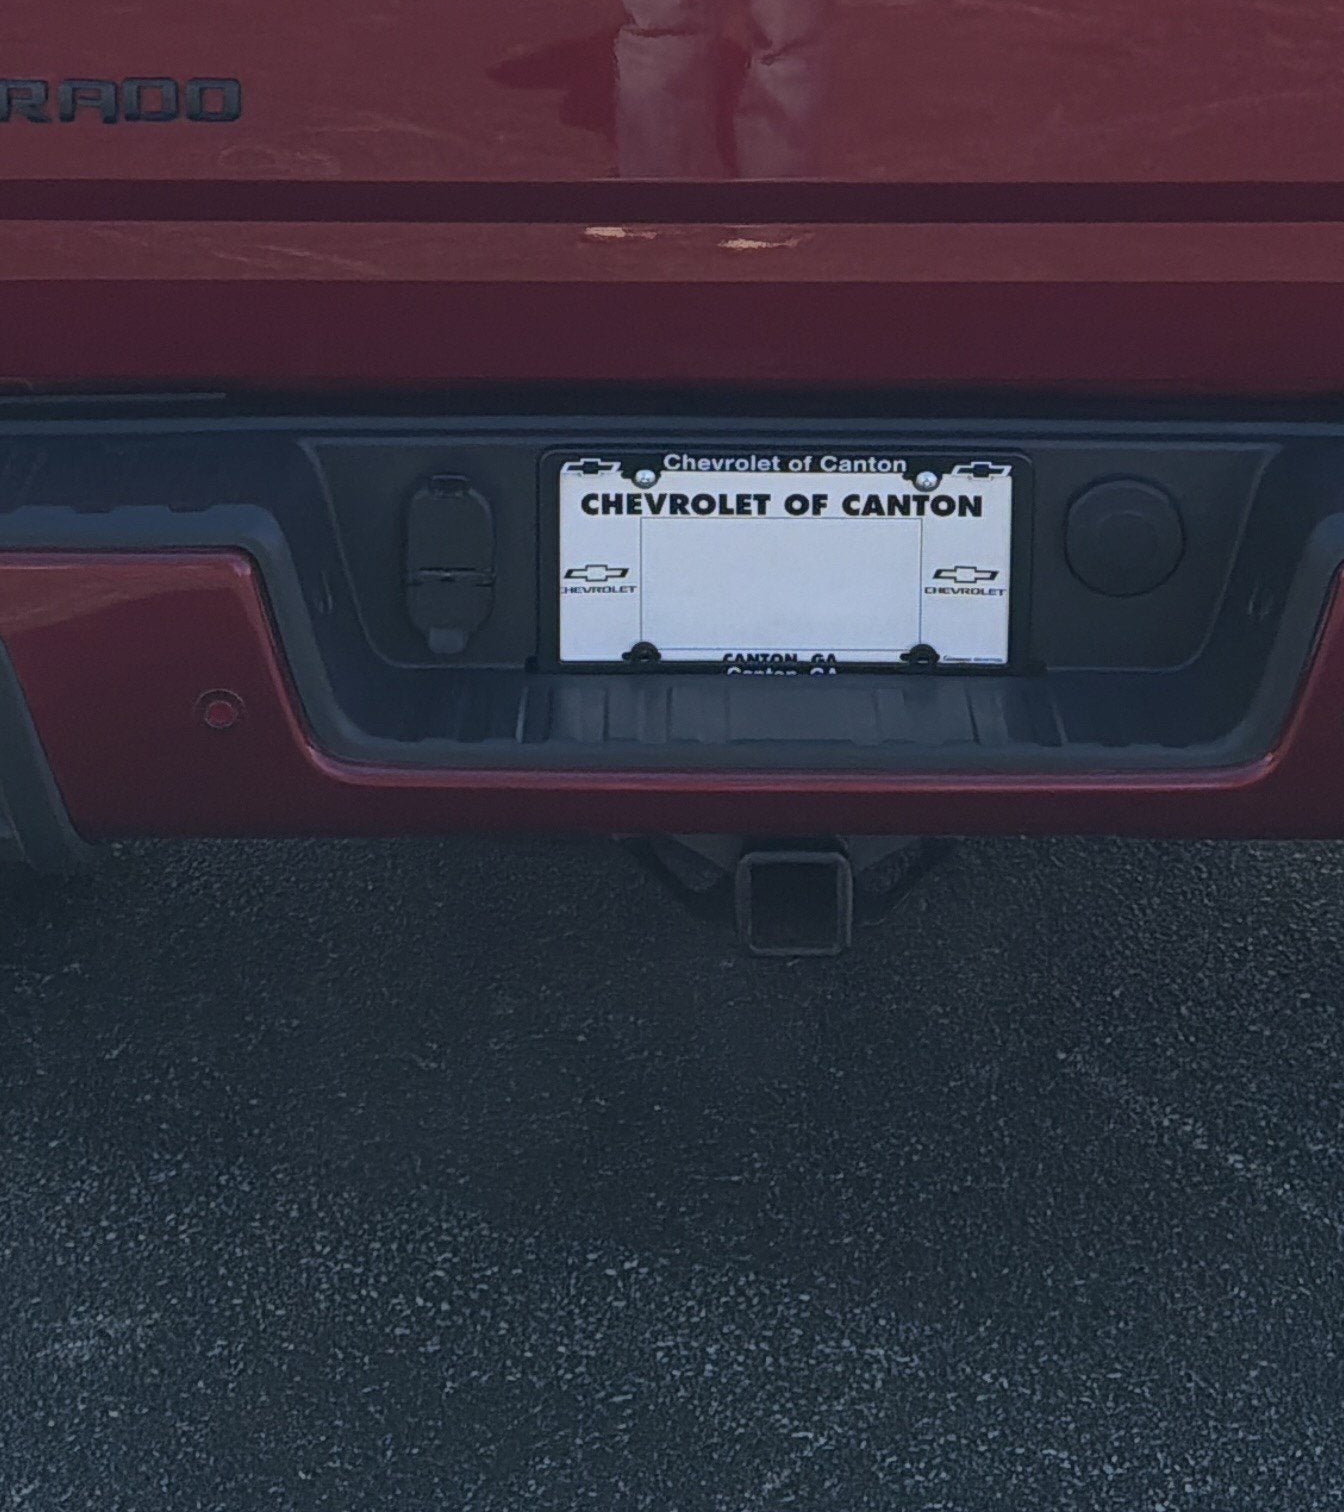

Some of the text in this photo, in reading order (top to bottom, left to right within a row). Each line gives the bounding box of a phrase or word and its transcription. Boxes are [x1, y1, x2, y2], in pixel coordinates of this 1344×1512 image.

[663, 453, 907, 473] Chevrolet of Canton
[580, 492, 983, 518] CHEVROLET OF CANTON
[924, 587, 1006, 596] CHEVROLET
